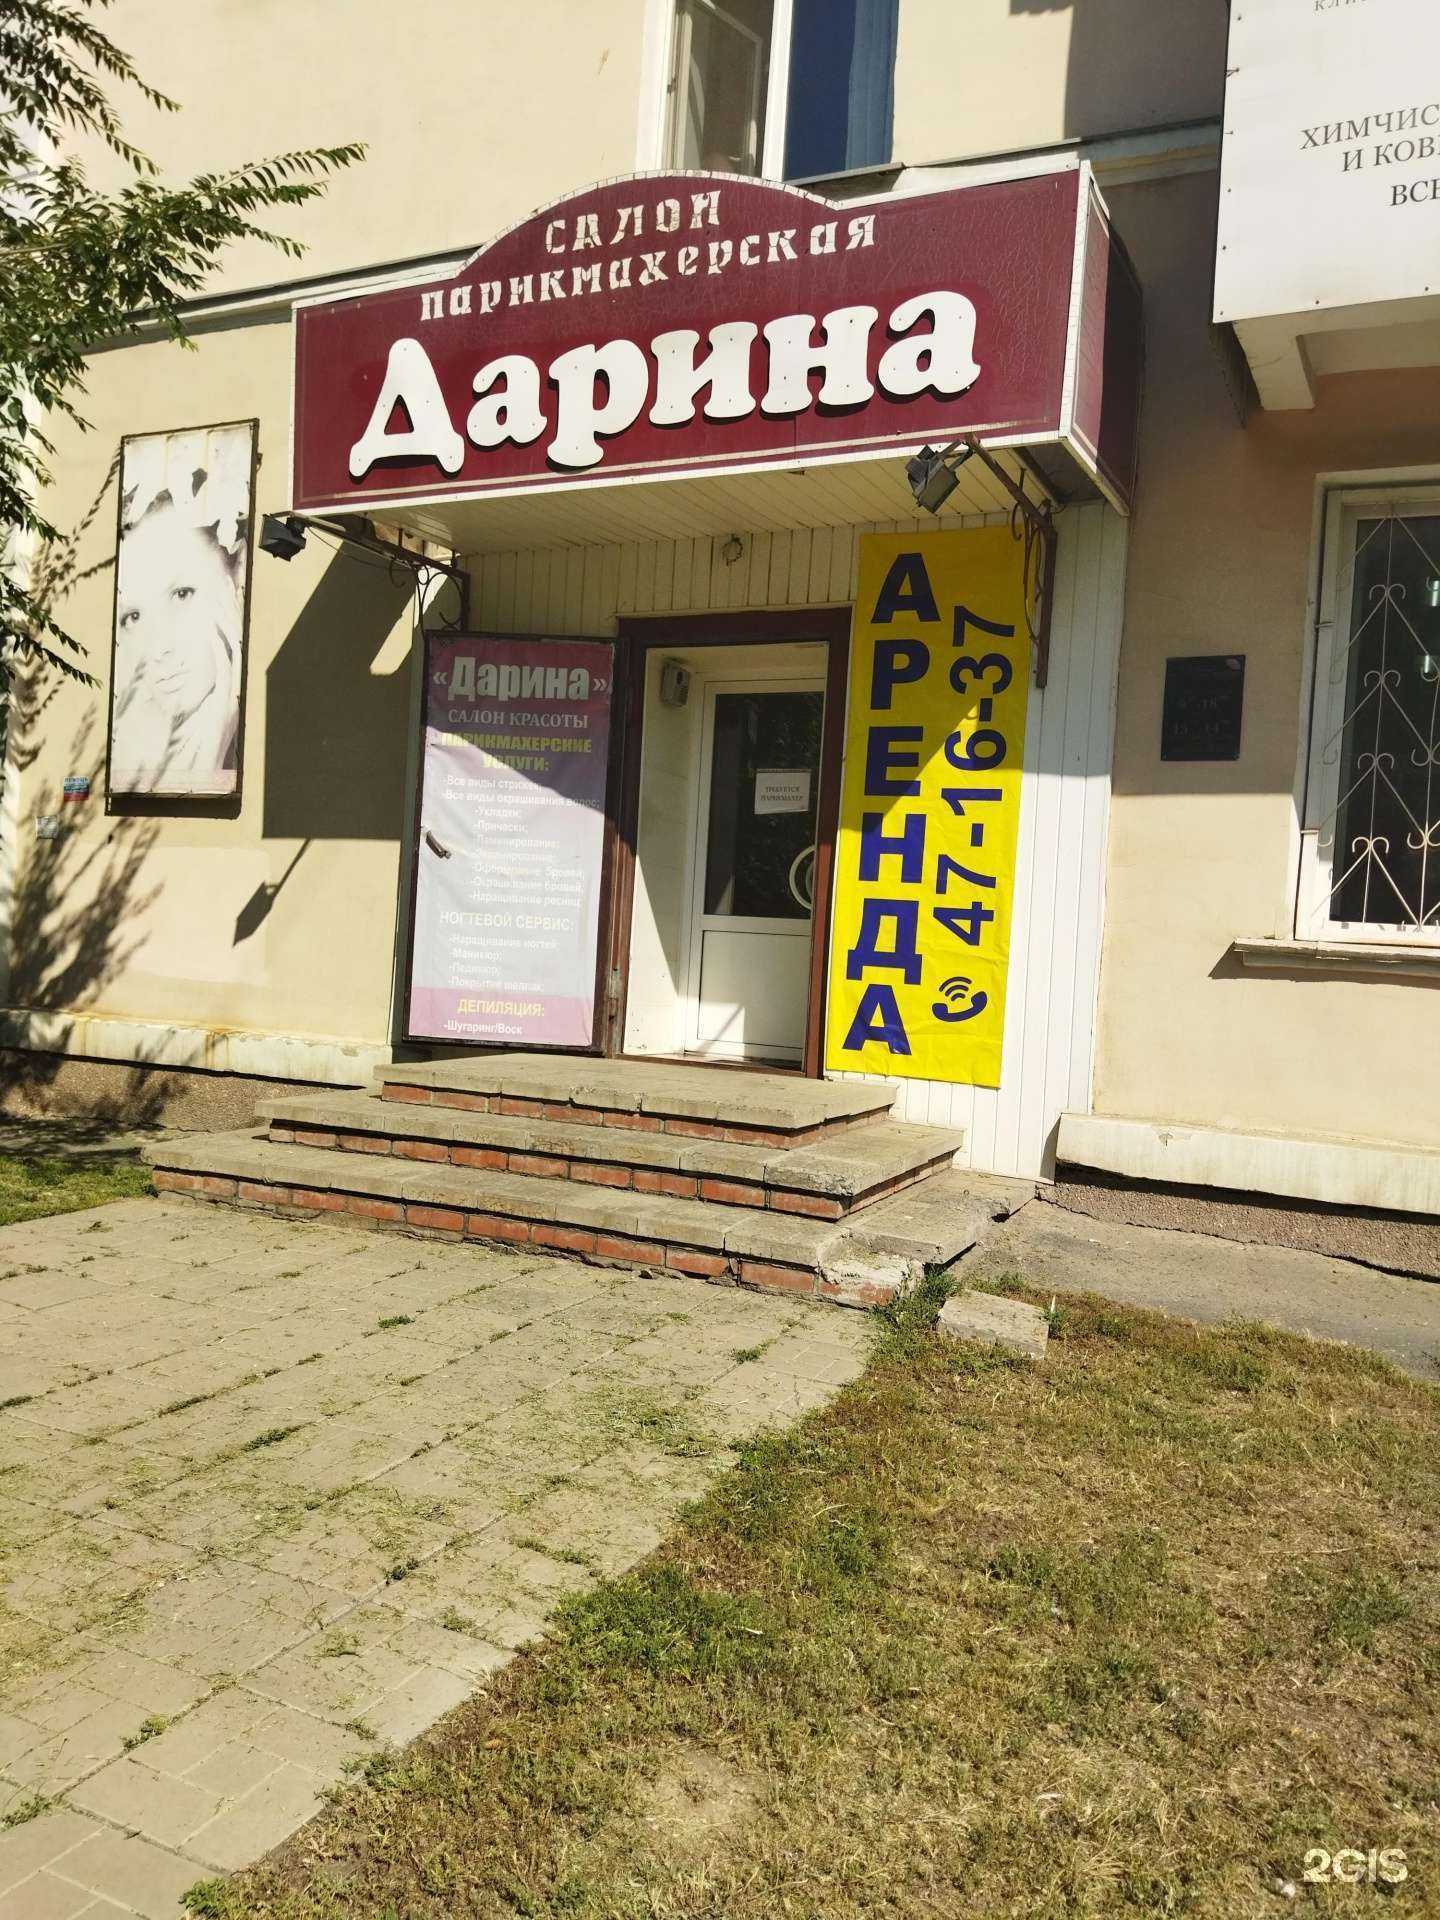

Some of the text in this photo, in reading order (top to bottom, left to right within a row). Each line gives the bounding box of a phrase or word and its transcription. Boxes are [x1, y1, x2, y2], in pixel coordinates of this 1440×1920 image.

[1342, 134, 1440, 172] И КОВ
[545, 190, 721, 254] САЛОН
[420, 214, 877, 321] парикмахерская
[349, 290, 982, 476] Дарина
[432, 655, 609, 702] «Дарина»
[440, 731, 592, 753] ПАРИКМАХЕРСКИЕ
[447, 708, 589, 729] САЛОН КРАСОТЫ
[932, 604, 1016, 947] 47-16-37
[841, 551, 941, 1056] АРЕНДА
[440, 911, 512, 929] НОГТЕВОЙ
[457, 999, 546, 1018] ДЕПИЛЯЦИЯ:
